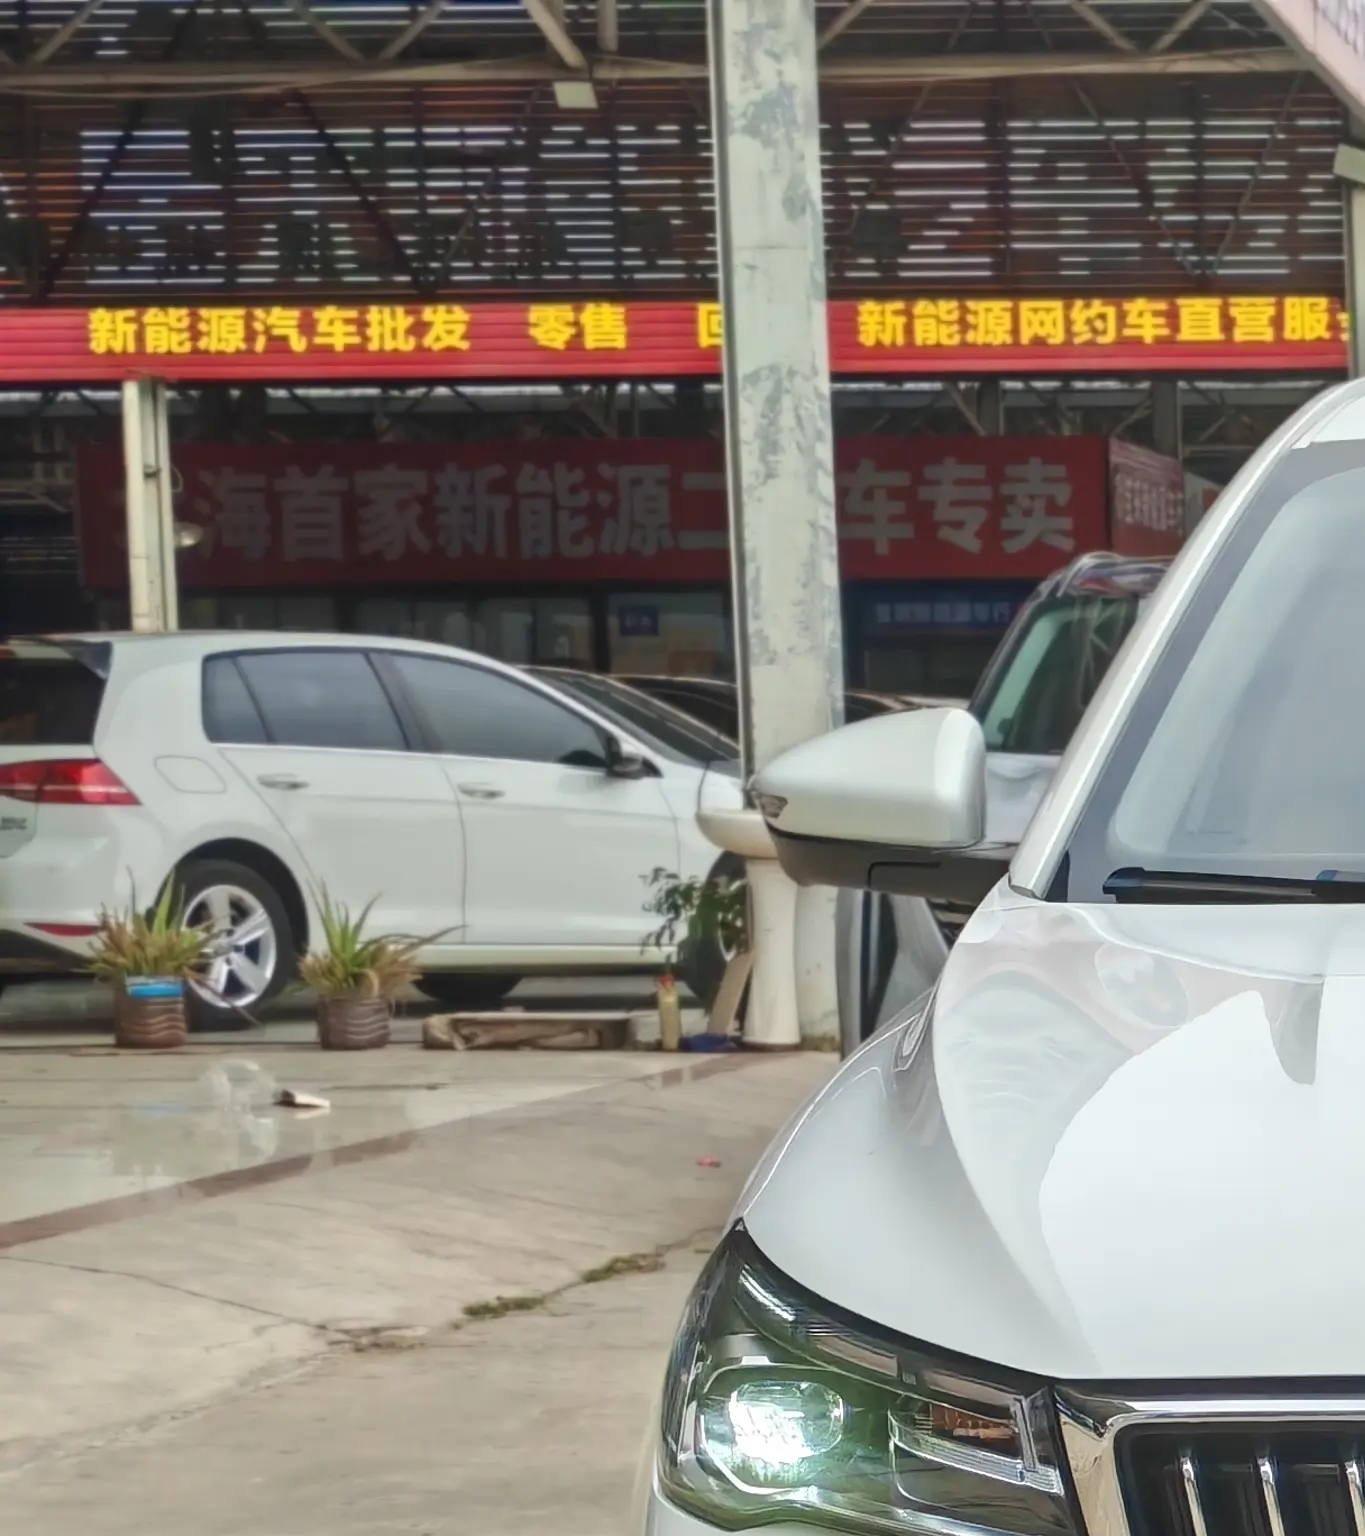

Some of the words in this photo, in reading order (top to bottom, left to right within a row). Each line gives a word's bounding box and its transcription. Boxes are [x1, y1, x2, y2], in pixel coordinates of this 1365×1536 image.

[88, 304, 471, 355] 新能源汽车批发
[527, 302, 630, 351] 零售
